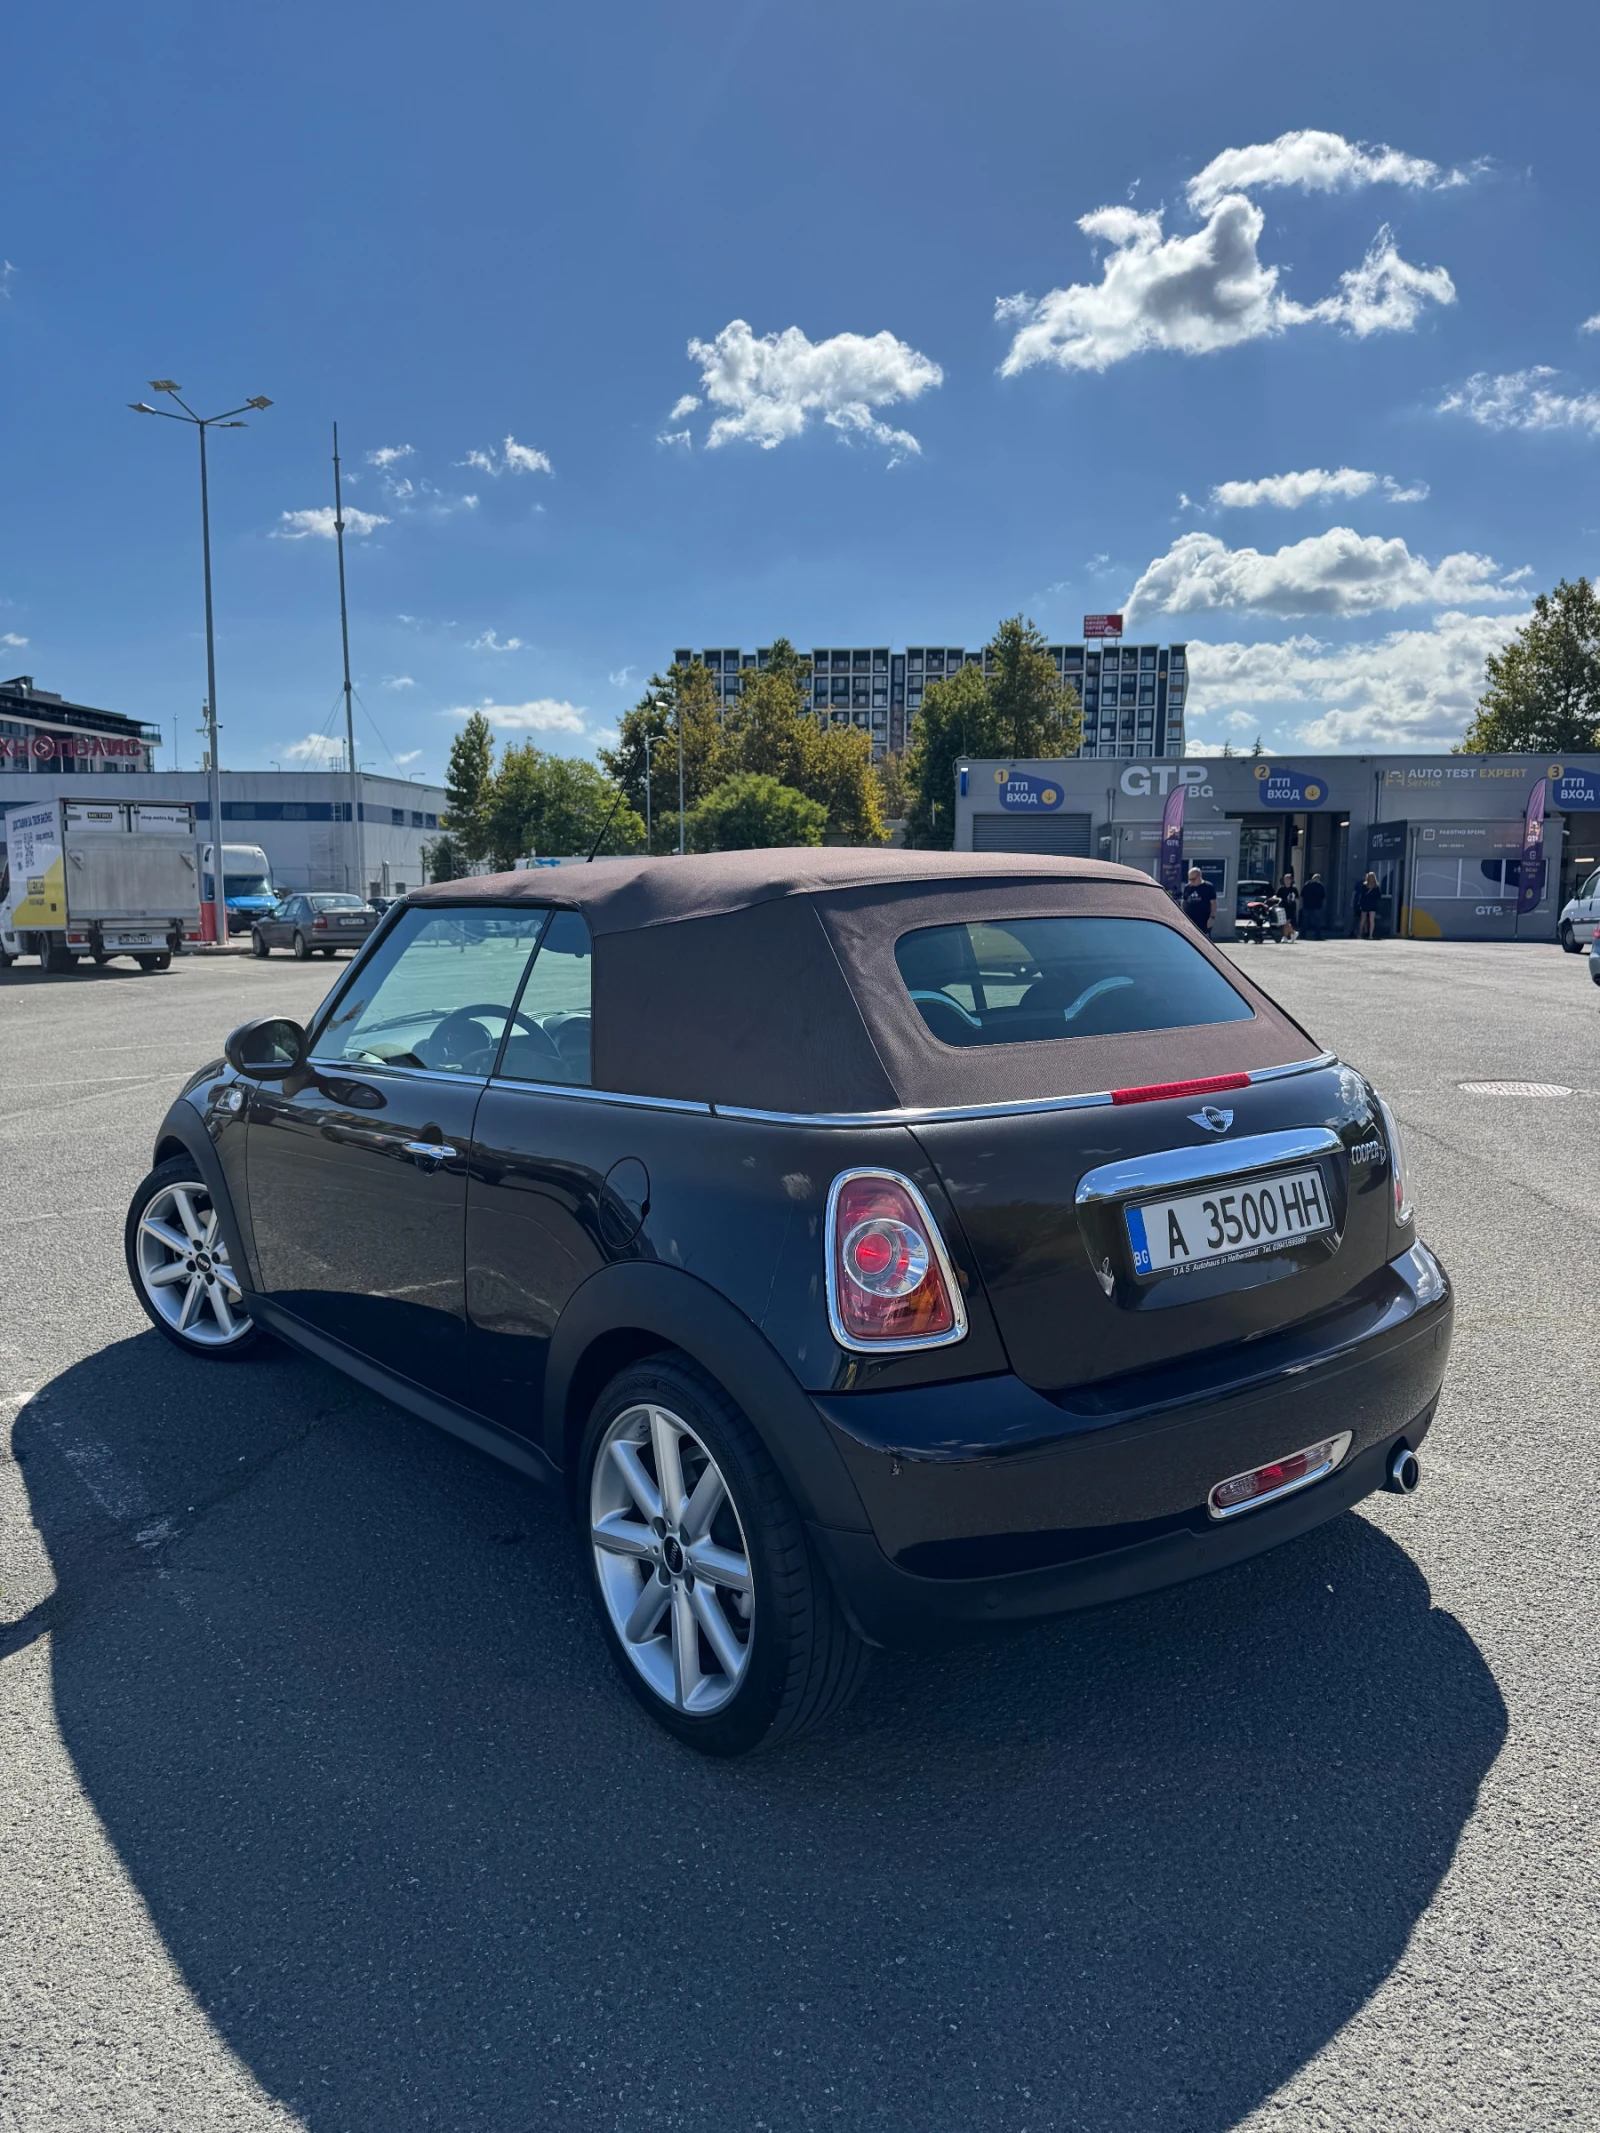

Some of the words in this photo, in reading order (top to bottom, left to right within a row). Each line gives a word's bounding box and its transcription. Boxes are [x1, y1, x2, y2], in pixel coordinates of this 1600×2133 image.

[998, 770, 1004, 782] 1
[1258, 766, 1267, 778] 2
[1408, 768, 1442, 778] AUTO
[1445, 768, 1477, 778] TEST
[1479, 768, 1528, 778] EXPERT
[1551, 766, 1560, 778] 3
[1007, 781, 1028, 791] ГТП
[1120, 765, 1208, 796] GTP
[1188, 785, 1213, 797] BG
[1268, 777, 1290, 788] ГТП
[1407, 778, 1441, 787] Service
[1562, 777, 1585, 788] ГТП
[1006, 793, 1038, 804] ВХОД
[1267, 789, 1300, 801] ВХОД
[1560, 789, 1595, 801] ВХОД
[1351, 1140, 1379, 1165] COOPER
[1167, 1208, 1190, 1259] A
[1133, 1250, 1149, 1266] BG
[1192, 1259, 1220, 1272] Autohaus
